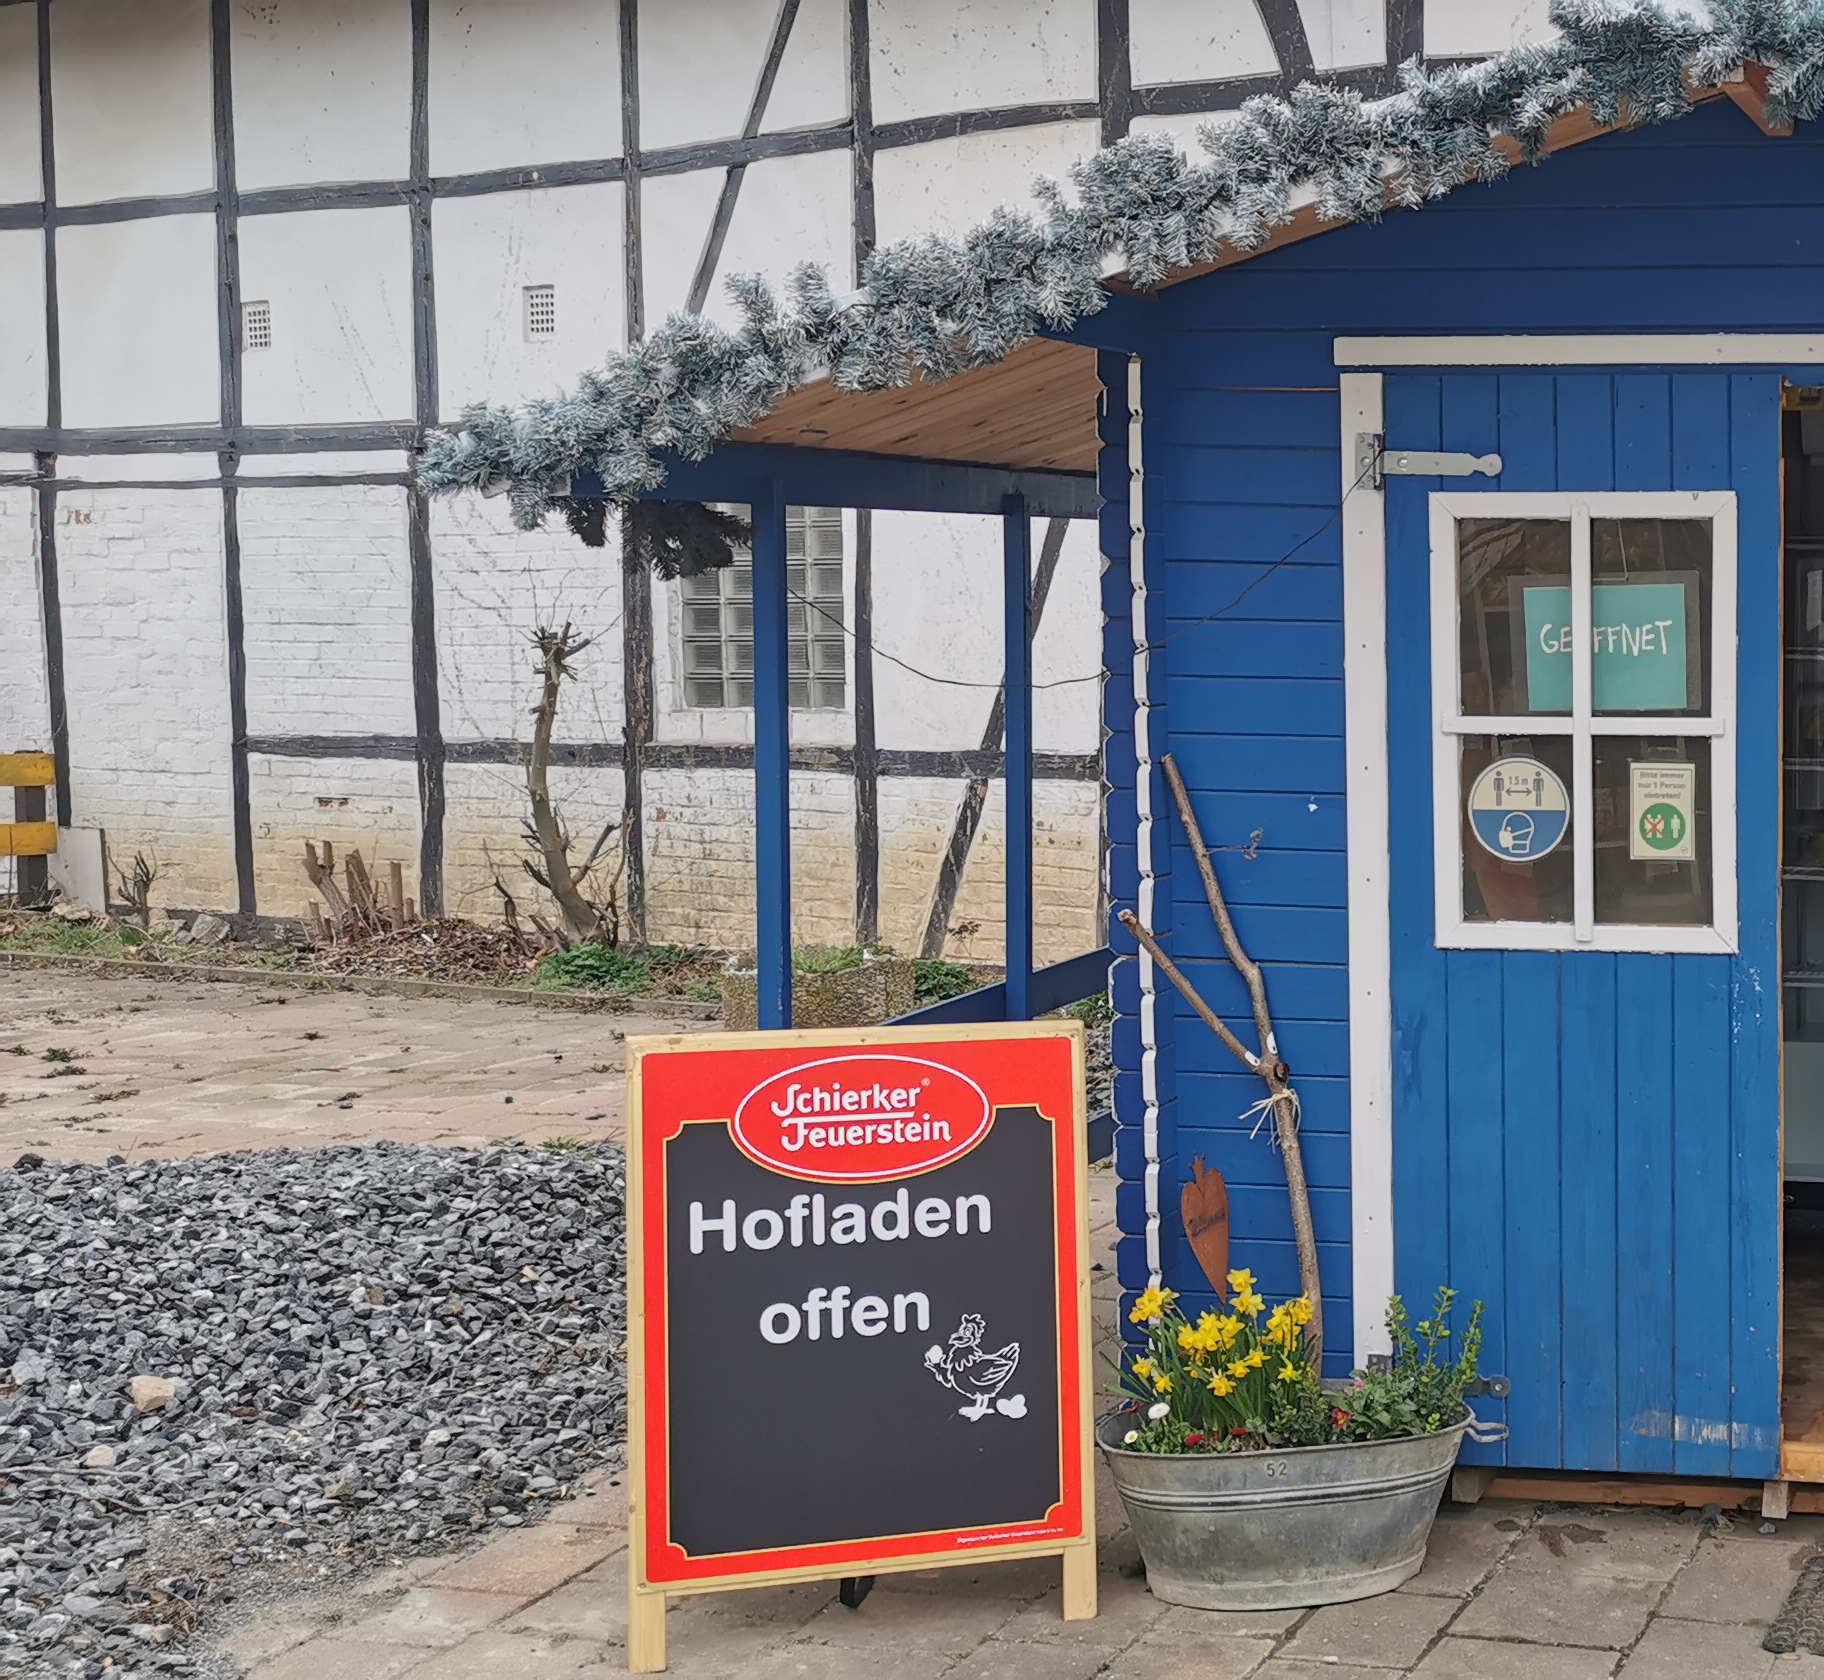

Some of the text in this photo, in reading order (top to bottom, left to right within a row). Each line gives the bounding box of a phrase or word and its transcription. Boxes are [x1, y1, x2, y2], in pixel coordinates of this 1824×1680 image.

[1540, 620, 1673, 657] GEFFNET
[1660, 781, 1687, 789] Person
[771, 1082, 921, 1117] Schierker
[781, 1112, 952, 1152] Feuerstein
[689, 1187, 992, 1255] Hofladen
[759, 1285, 931, 1345] offen
[1266, 1461, 1288, 1477] 52
